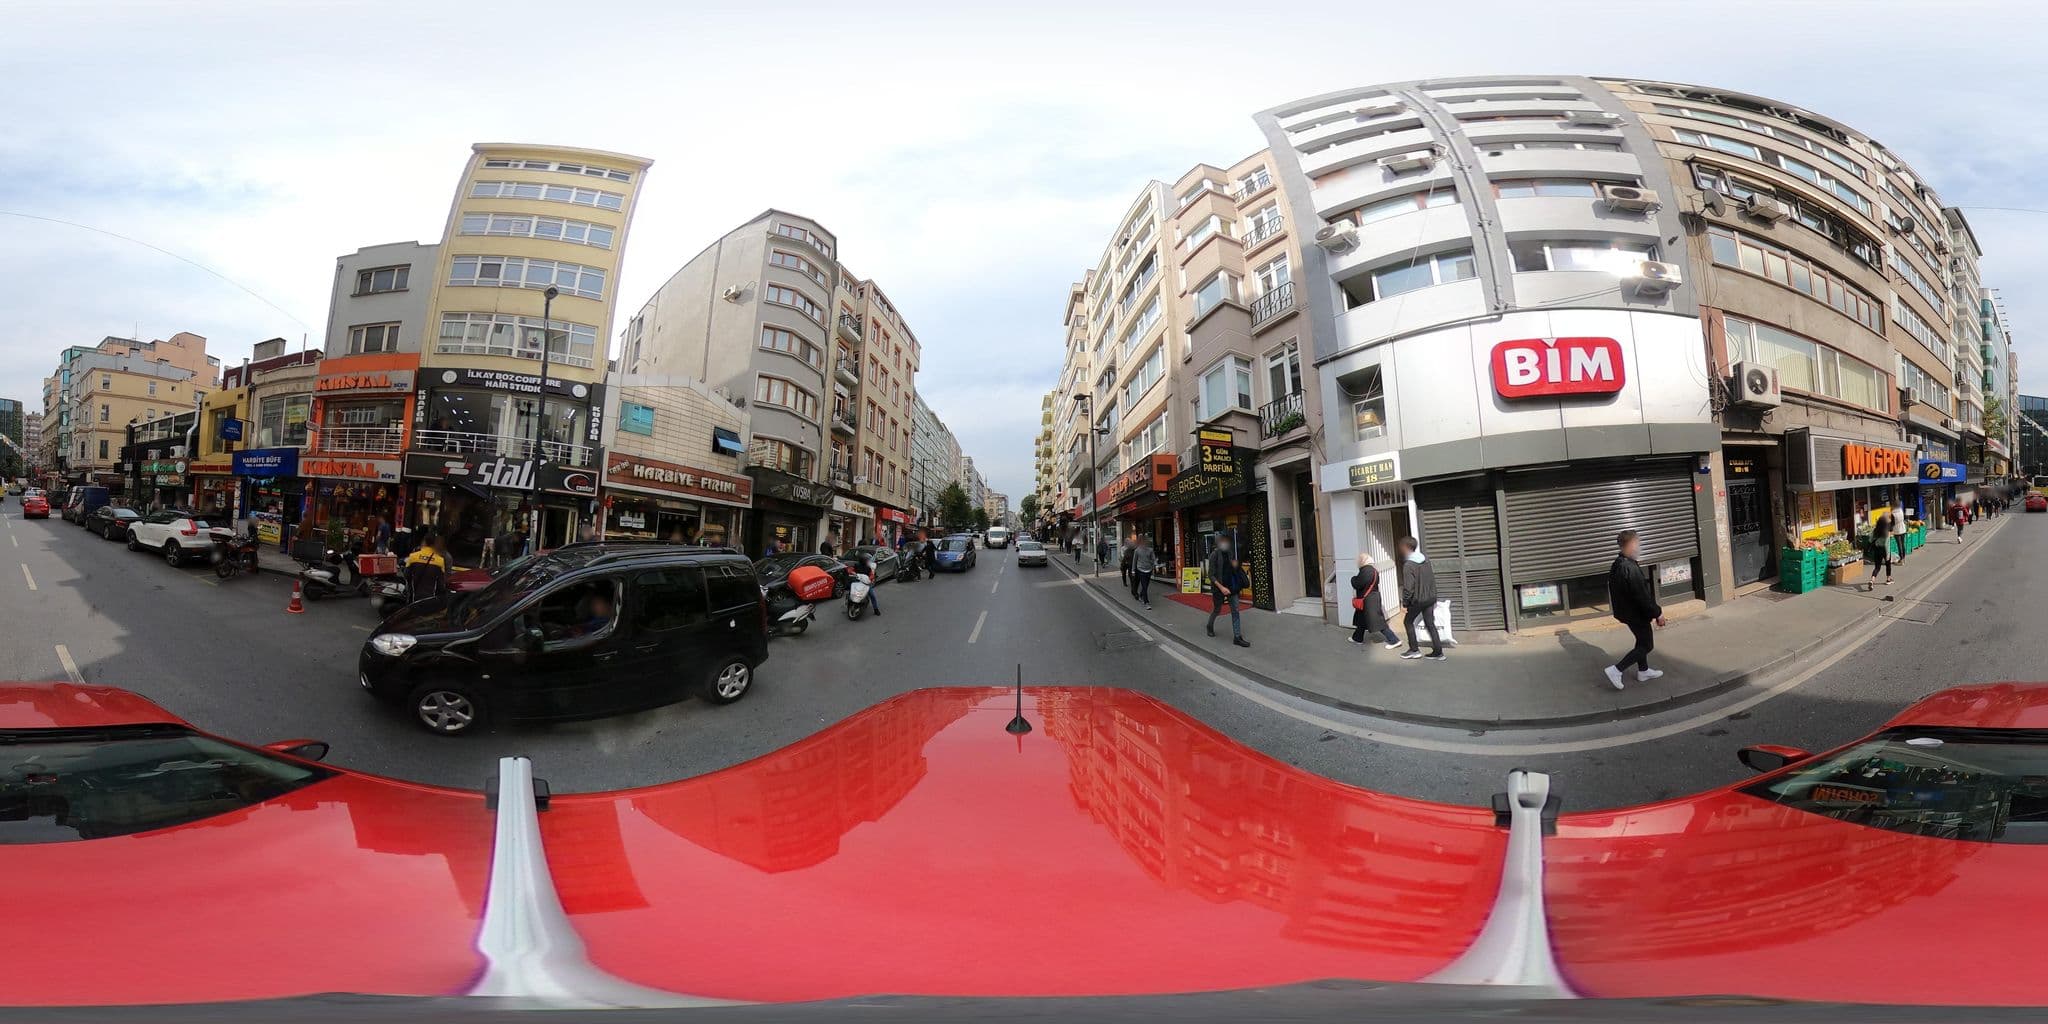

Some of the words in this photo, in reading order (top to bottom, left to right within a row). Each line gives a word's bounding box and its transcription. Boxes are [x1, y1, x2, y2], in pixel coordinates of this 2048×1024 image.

[467, 369, 495, 380] İLKAY
[496, 372, 515, 381] BOZ
[485, 380, 508, 389] HAİR
[416, 389, 426, 423] KUAFÖR
[590, 405, 601, 441] KUAFÖR
[1202, 445, 1213, 463] 3
[303, 458, 380, 479] KRİSTAL
[633, 463, 695, 487] HARBİYE
[1203, 462, 1233, 473] PARFÜM
[1366, 473, 1378, 484] 18
